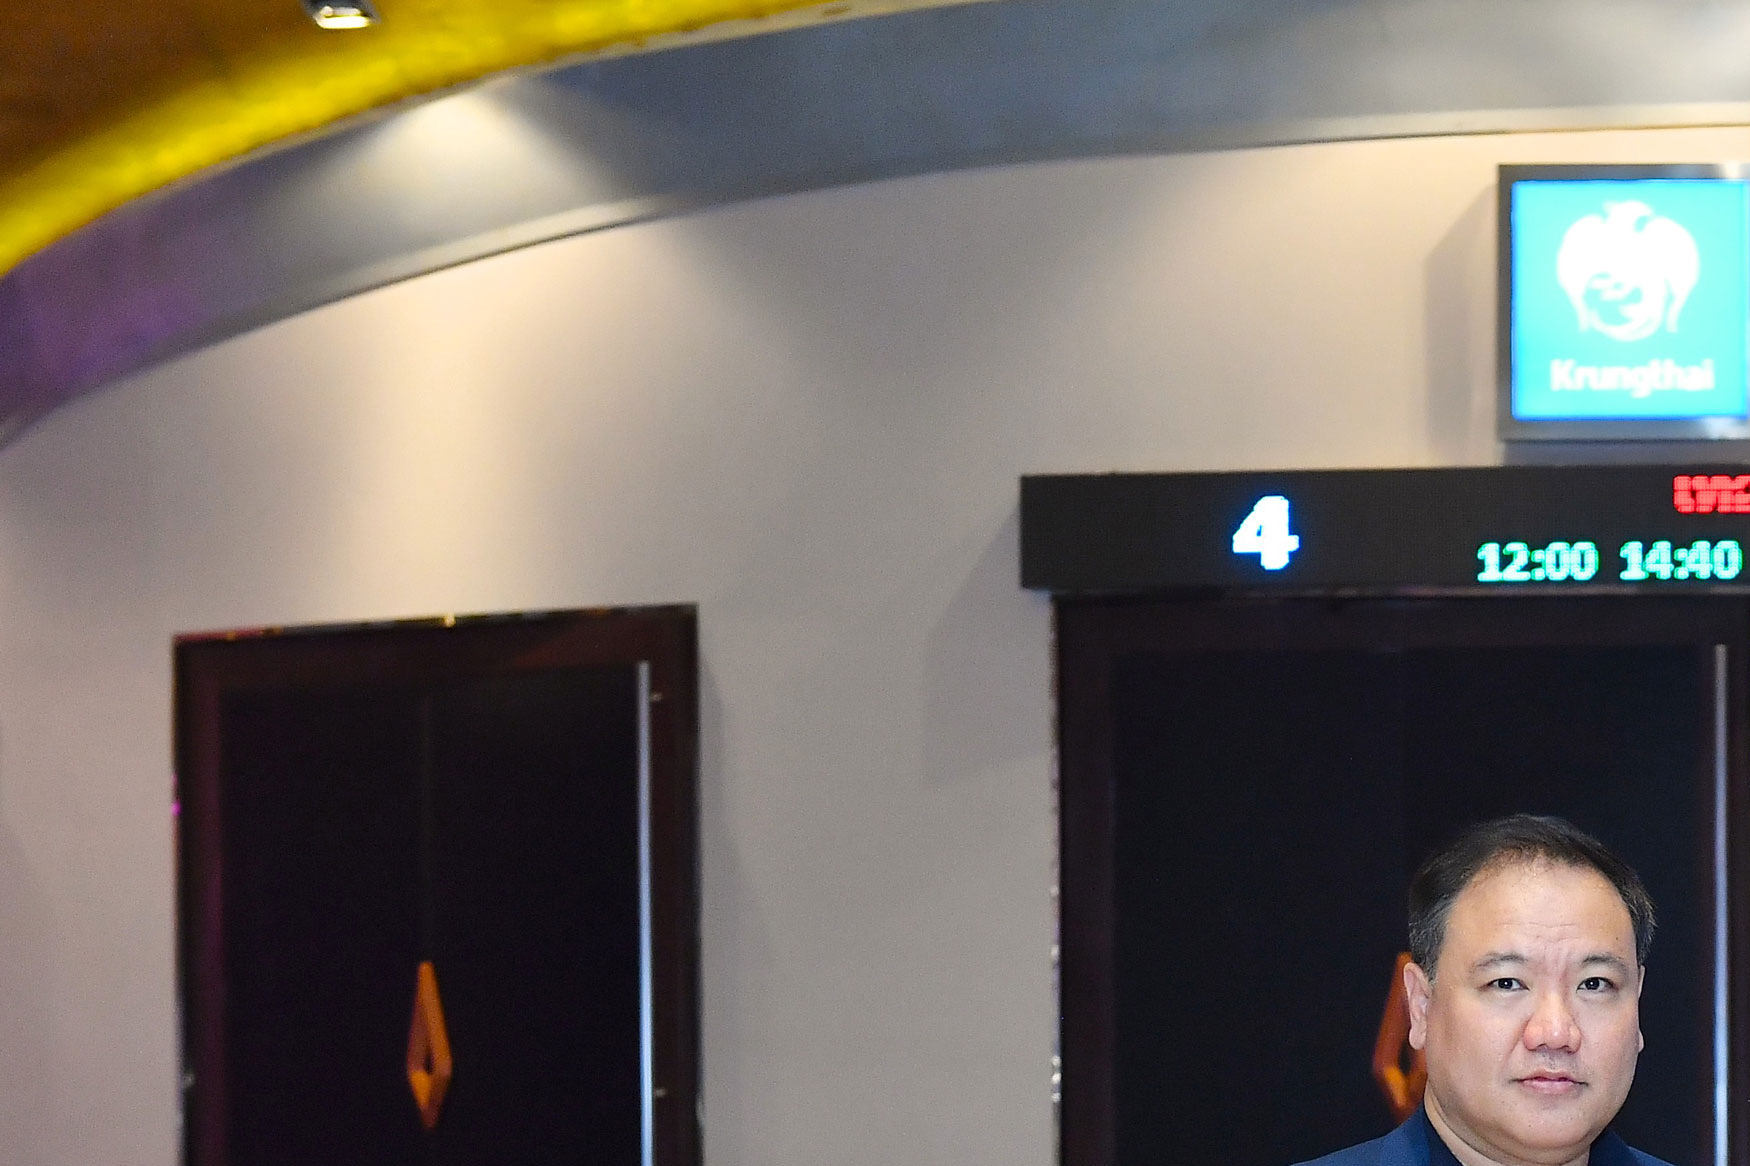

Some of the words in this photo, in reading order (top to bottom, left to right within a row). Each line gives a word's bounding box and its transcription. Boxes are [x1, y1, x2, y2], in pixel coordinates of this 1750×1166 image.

[1550, 359, 1715, 399] Krungthai
[1232, 495, 1300, 571] 4
[1476, 540, 1600, 583] 12:00
[1618, 539, 1743, 582] 14:40
